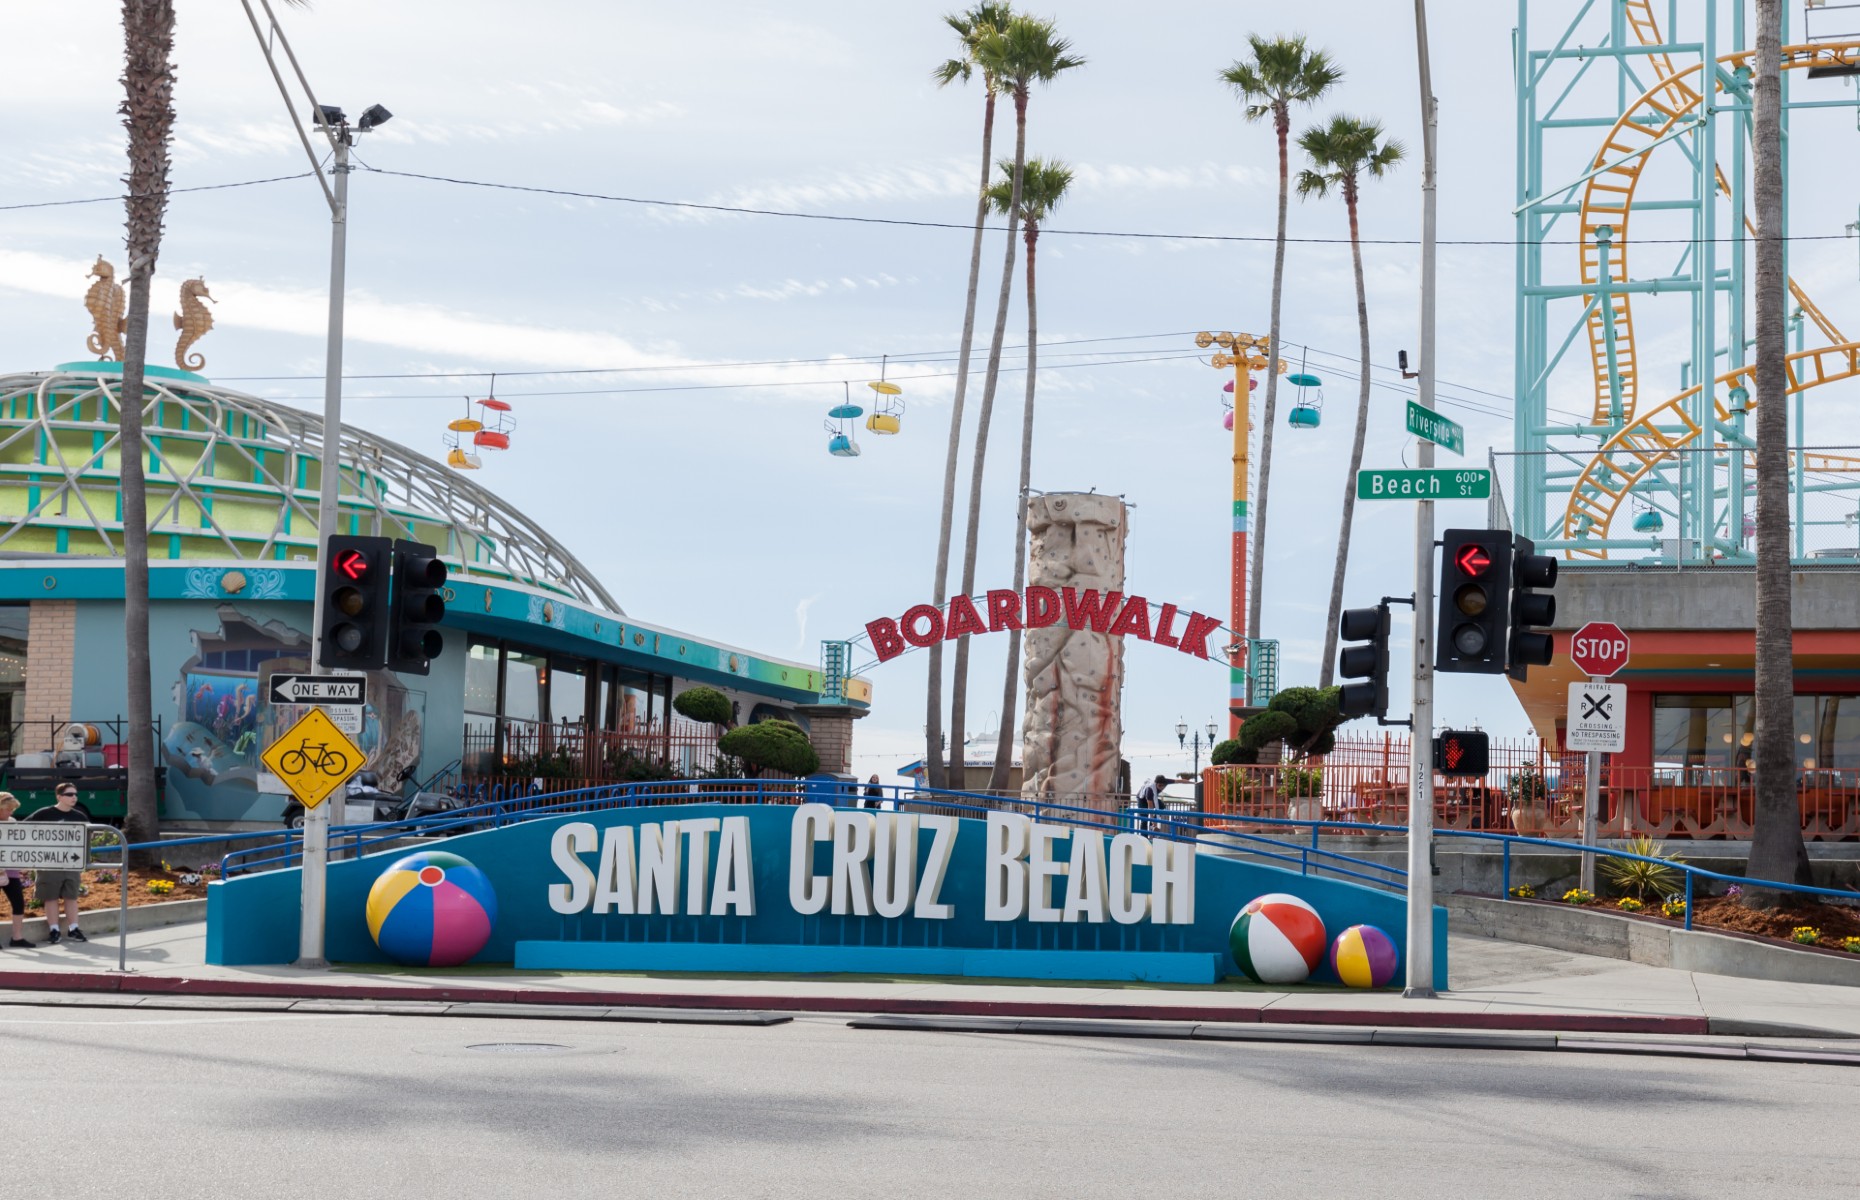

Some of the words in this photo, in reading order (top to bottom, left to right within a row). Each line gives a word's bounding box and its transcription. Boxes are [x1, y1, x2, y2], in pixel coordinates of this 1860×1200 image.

[1409, 406, 1450, 443] Riverside
[1372, 474, 1441, 495] Beach
[1455, 472, 1477, 483] 600
[1460, 484, 1472, 496] St
[865, 585, 1223, 663] BOARDWALK
[1575, 637, 1626, 660] STOP
[291, 683, 320, 696] ONE
[327, 684, 356, 697] WAY
[1584, 683, 1612, 691] PRIVATE
[7, 829, 26, 841] PED
[31, 829, 81, 842] CROSSING
[10, 850, 69, 863] CROSSWALK
[548, 815, 757, 916] SANTA
[789, 803, 960, 920] CRUZ
[985, 810, 1196, 925] BEACH
